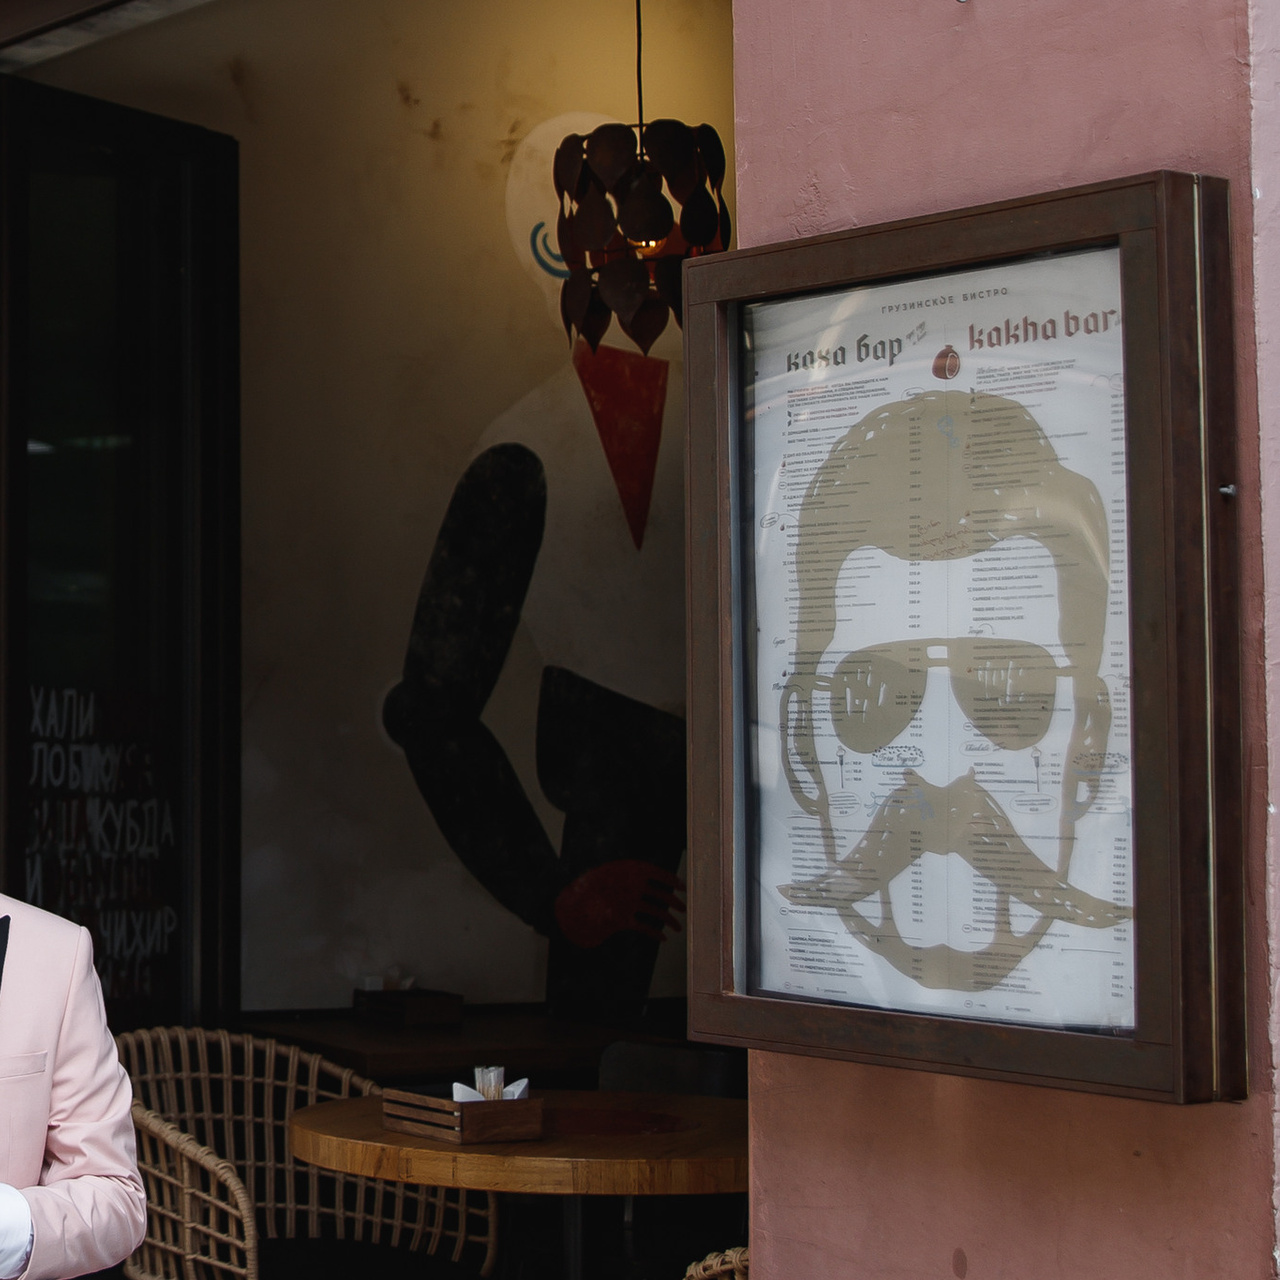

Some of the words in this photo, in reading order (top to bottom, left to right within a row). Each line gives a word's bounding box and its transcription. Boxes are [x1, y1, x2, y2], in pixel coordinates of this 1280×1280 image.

[881, 295, 955, 314] ГРУЗИНСКОЕ
[962, 287, 1009, 302] БИСТРО
[968, 315, 1057, 351] kakha
[1064, 309, 1118, 338] bar
